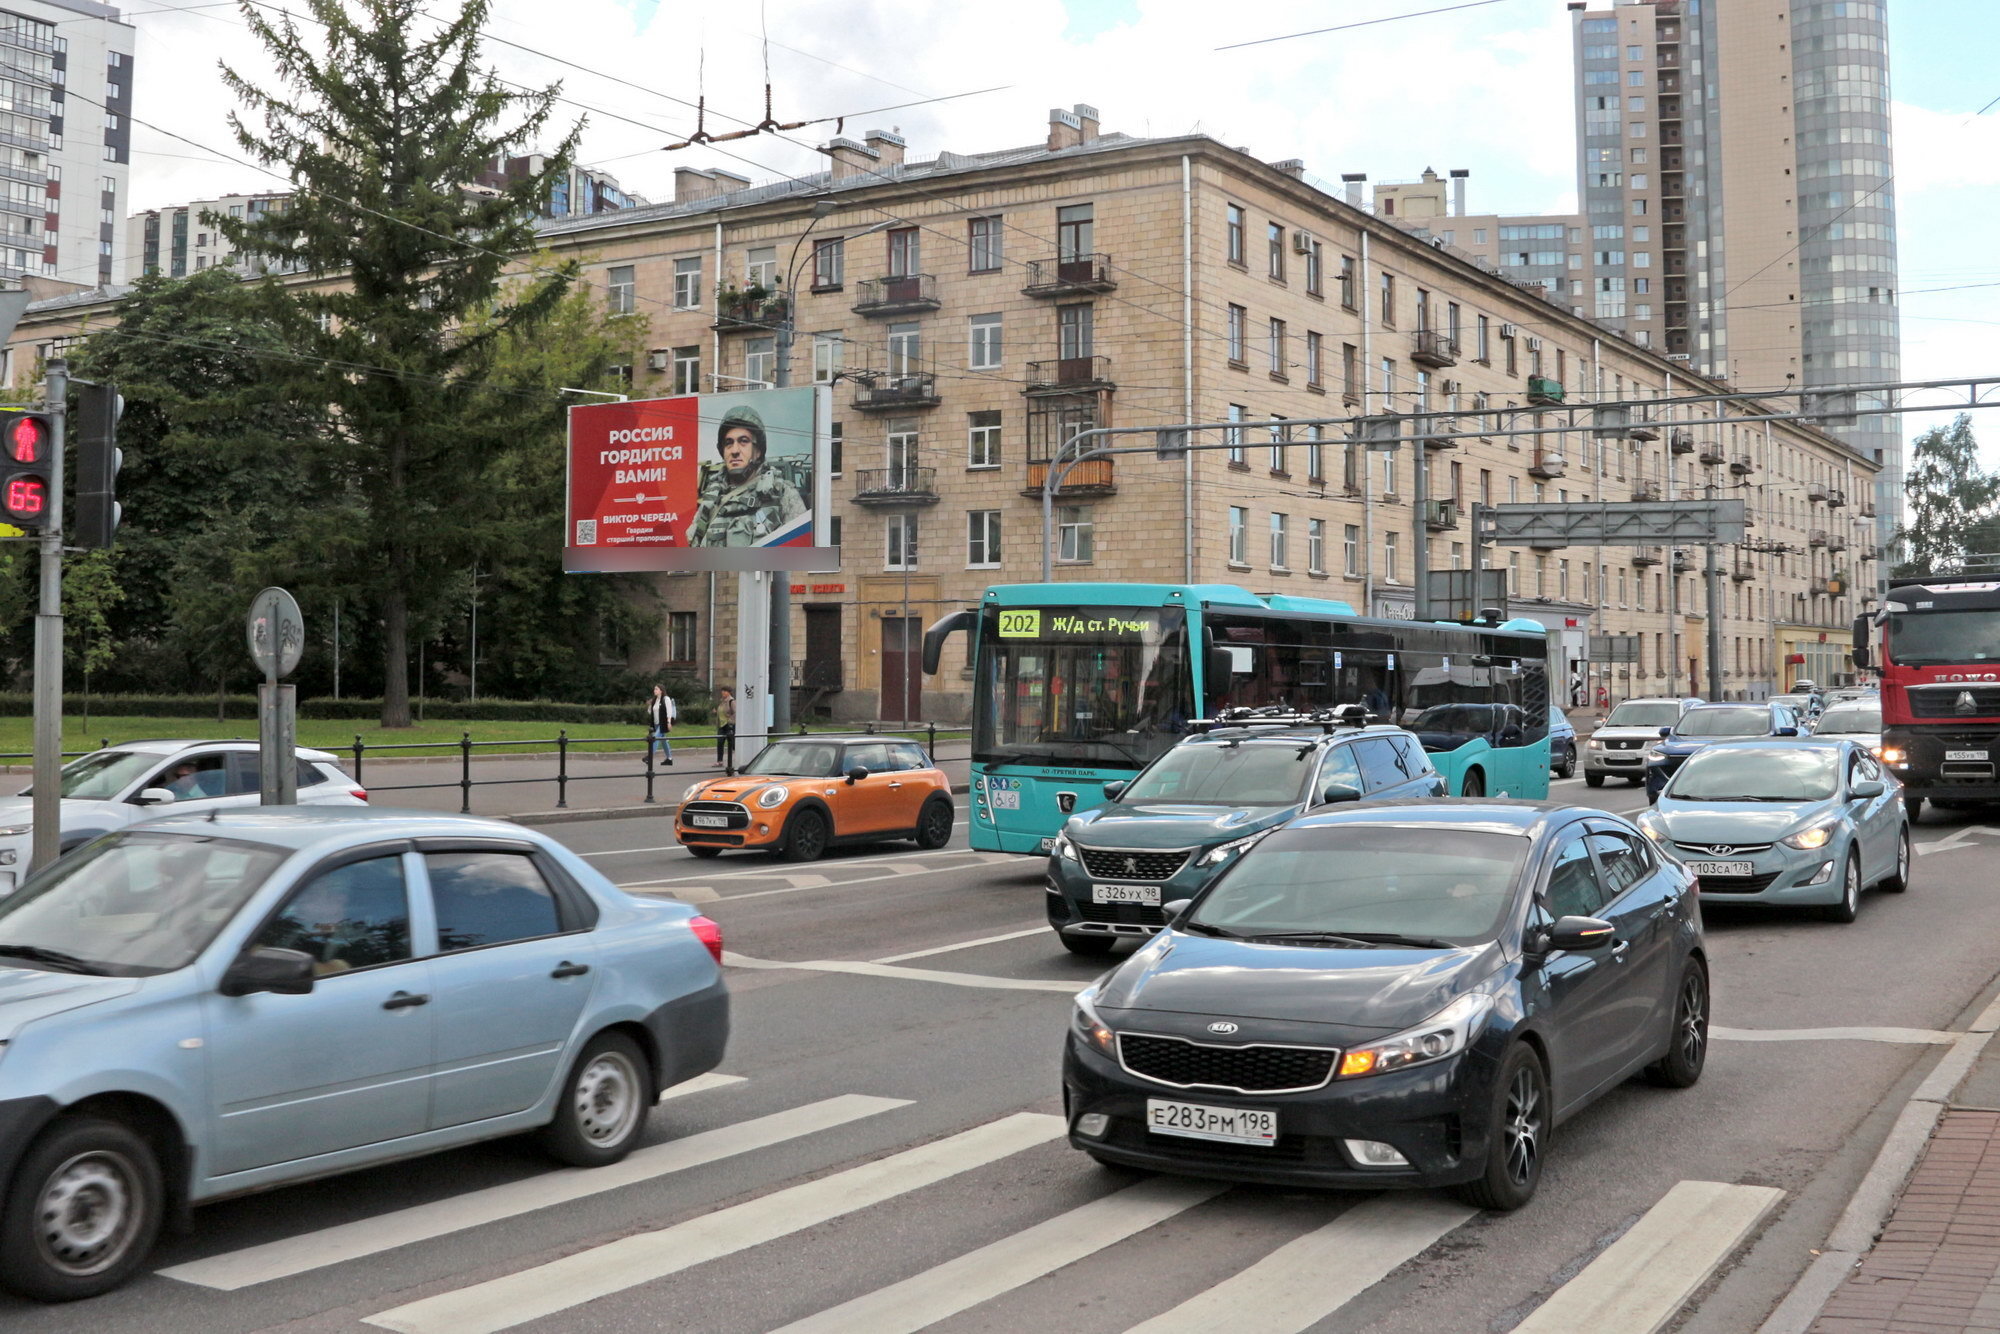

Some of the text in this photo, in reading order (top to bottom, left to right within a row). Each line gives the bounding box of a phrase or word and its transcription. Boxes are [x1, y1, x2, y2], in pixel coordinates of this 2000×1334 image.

[609, 426, 673, 444] РОССИЯ
[600, 446, 682, 465] ГОРДИТСЯ
[615, 468, 667, 484] ВАМИ!
[8, 480, 43, 512] 65
[603, 512, 678, 524] ВИКТОР ЧЕРЕДА
[606, 535, 674, 544] старший прапорщик
[1002, 615, 1149, 635] 202 Ж/д ст. Ручьи
[1934, 673, 1997, 682] HOWO
[1097, 886, 1142, 900] С326УХ
[1209, 1022, 1235, 1033] KIA
[1154, 1105, 1270, 1133] Е283РМ 198
